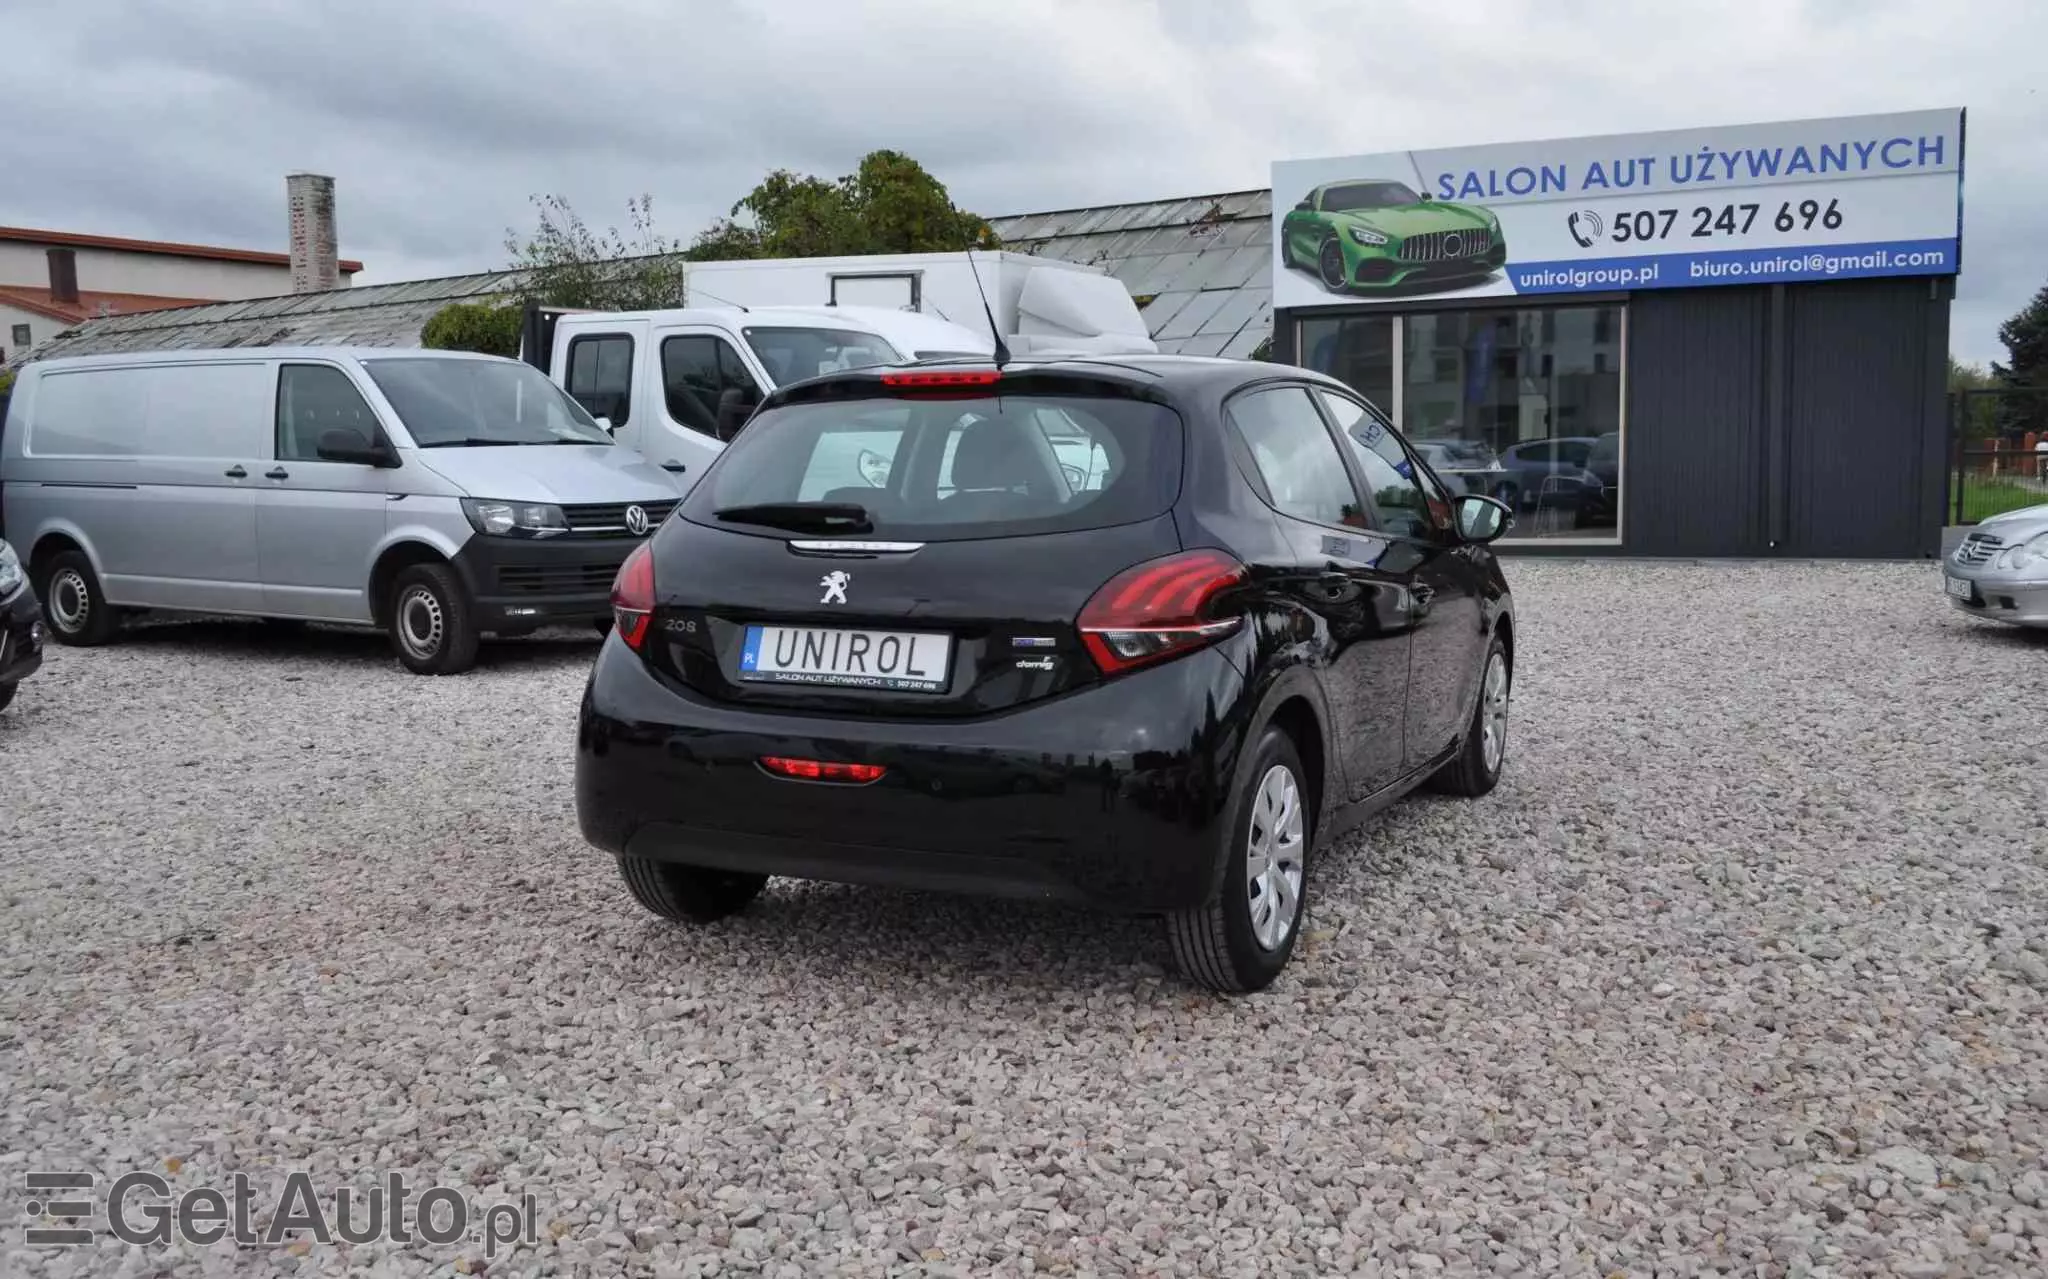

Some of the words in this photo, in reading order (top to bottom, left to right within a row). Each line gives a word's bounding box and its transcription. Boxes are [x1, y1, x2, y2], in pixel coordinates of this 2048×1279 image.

[1438, 164, 1567, 201] SALON
[1581, 157, 1656, 191] AUT
[1670, 135, 1944, 184] UŻYWANYCH
[1612, 208, 1679, 243] 507
[1691, 203, 1760, 238] 247
[1774, 198, 1843, 233] 696
[1520, 264, 1659, 288] unirolgroup.pl
[1690, 249, 1944, 278] biuro.unirol@gmail.com
[664, 619, 697, 632] 208
[744, 654, 755, 664] PL
[775, 630, 926, 678] UNIROL
